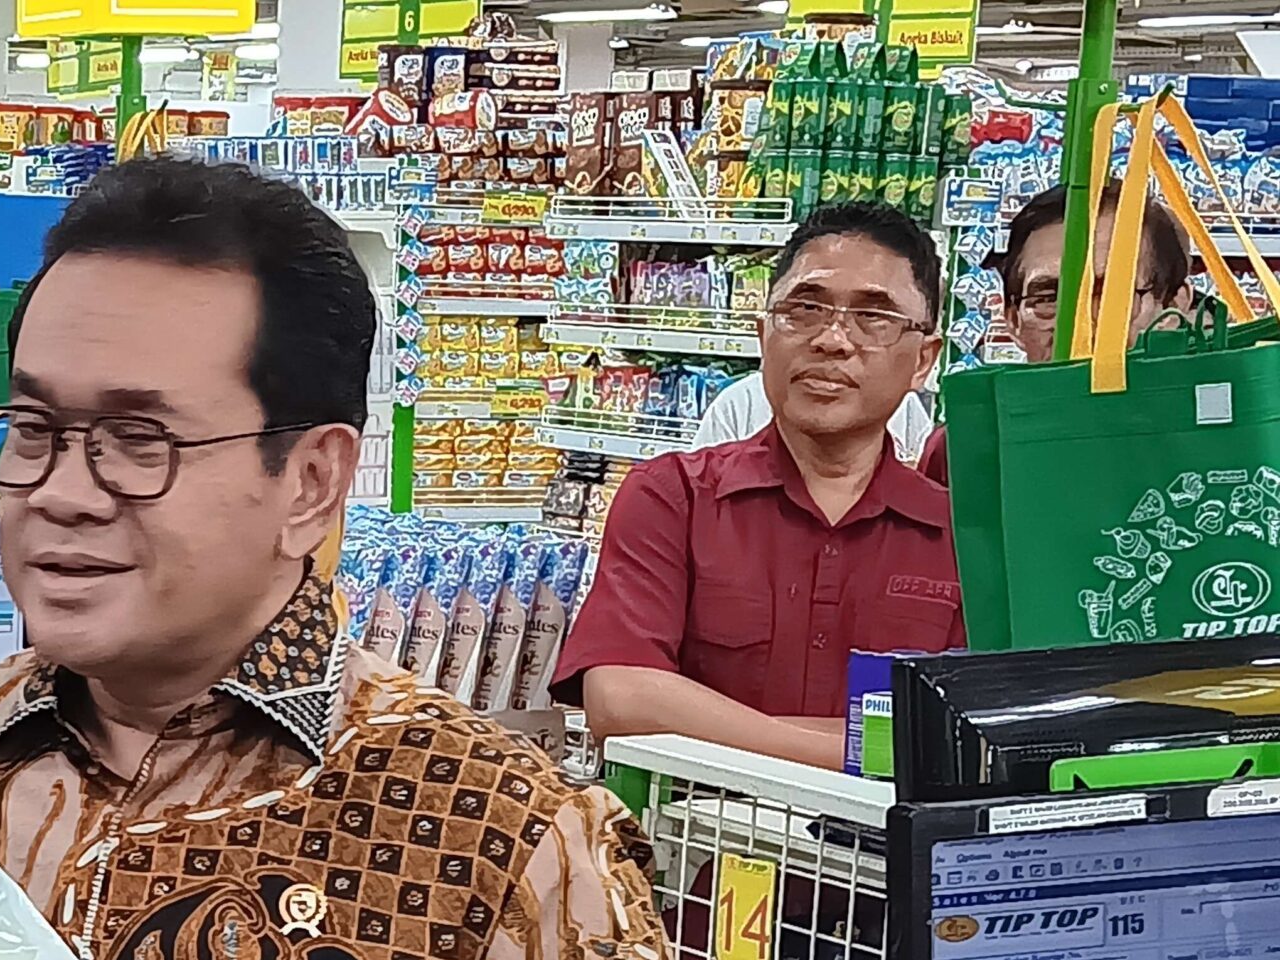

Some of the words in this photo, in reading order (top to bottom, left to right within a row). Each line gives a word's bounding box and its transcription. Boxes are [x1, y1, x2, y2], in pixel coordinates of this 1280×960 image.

[404, 11, 415, 32] 6
[1182, 620, 1227, 638] TIP
[720, 887, 770, 960] 14
[984, 913, 1035, 934] TIP
[1039, 907, 1100, 930] TOP
[1108, 912, 1145, 937] 115
